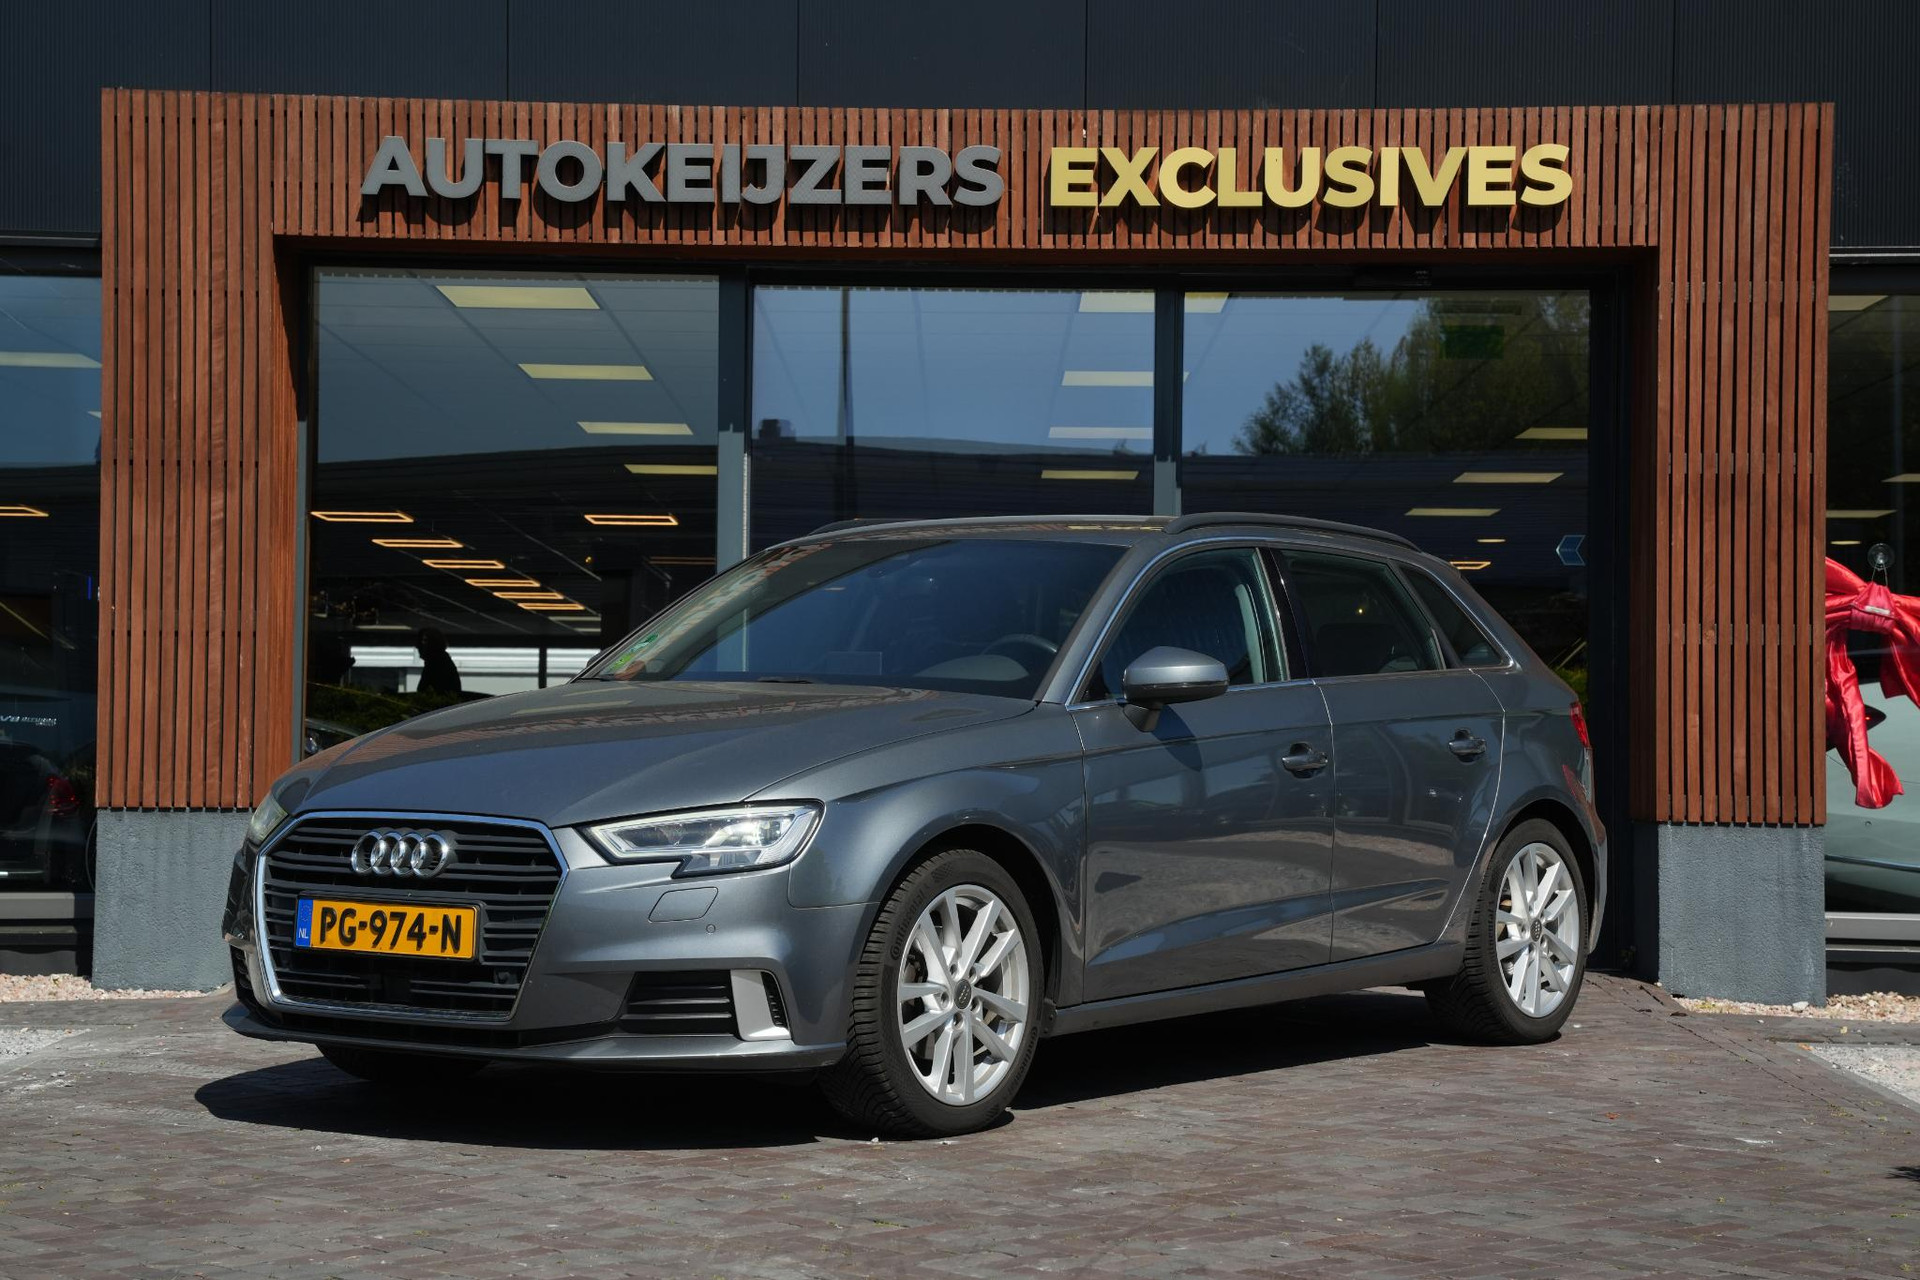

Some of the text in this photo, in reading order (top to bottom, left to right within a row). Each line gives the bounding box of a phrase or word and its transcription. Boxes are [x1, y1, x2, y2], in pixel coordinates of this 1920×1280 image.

[361, 135, 1573, 208] AUTOKEIJZERS EXCLUSIVES
[298, 927, 309, 939] NL
[319, 906, 462, 954] PG-974-N
